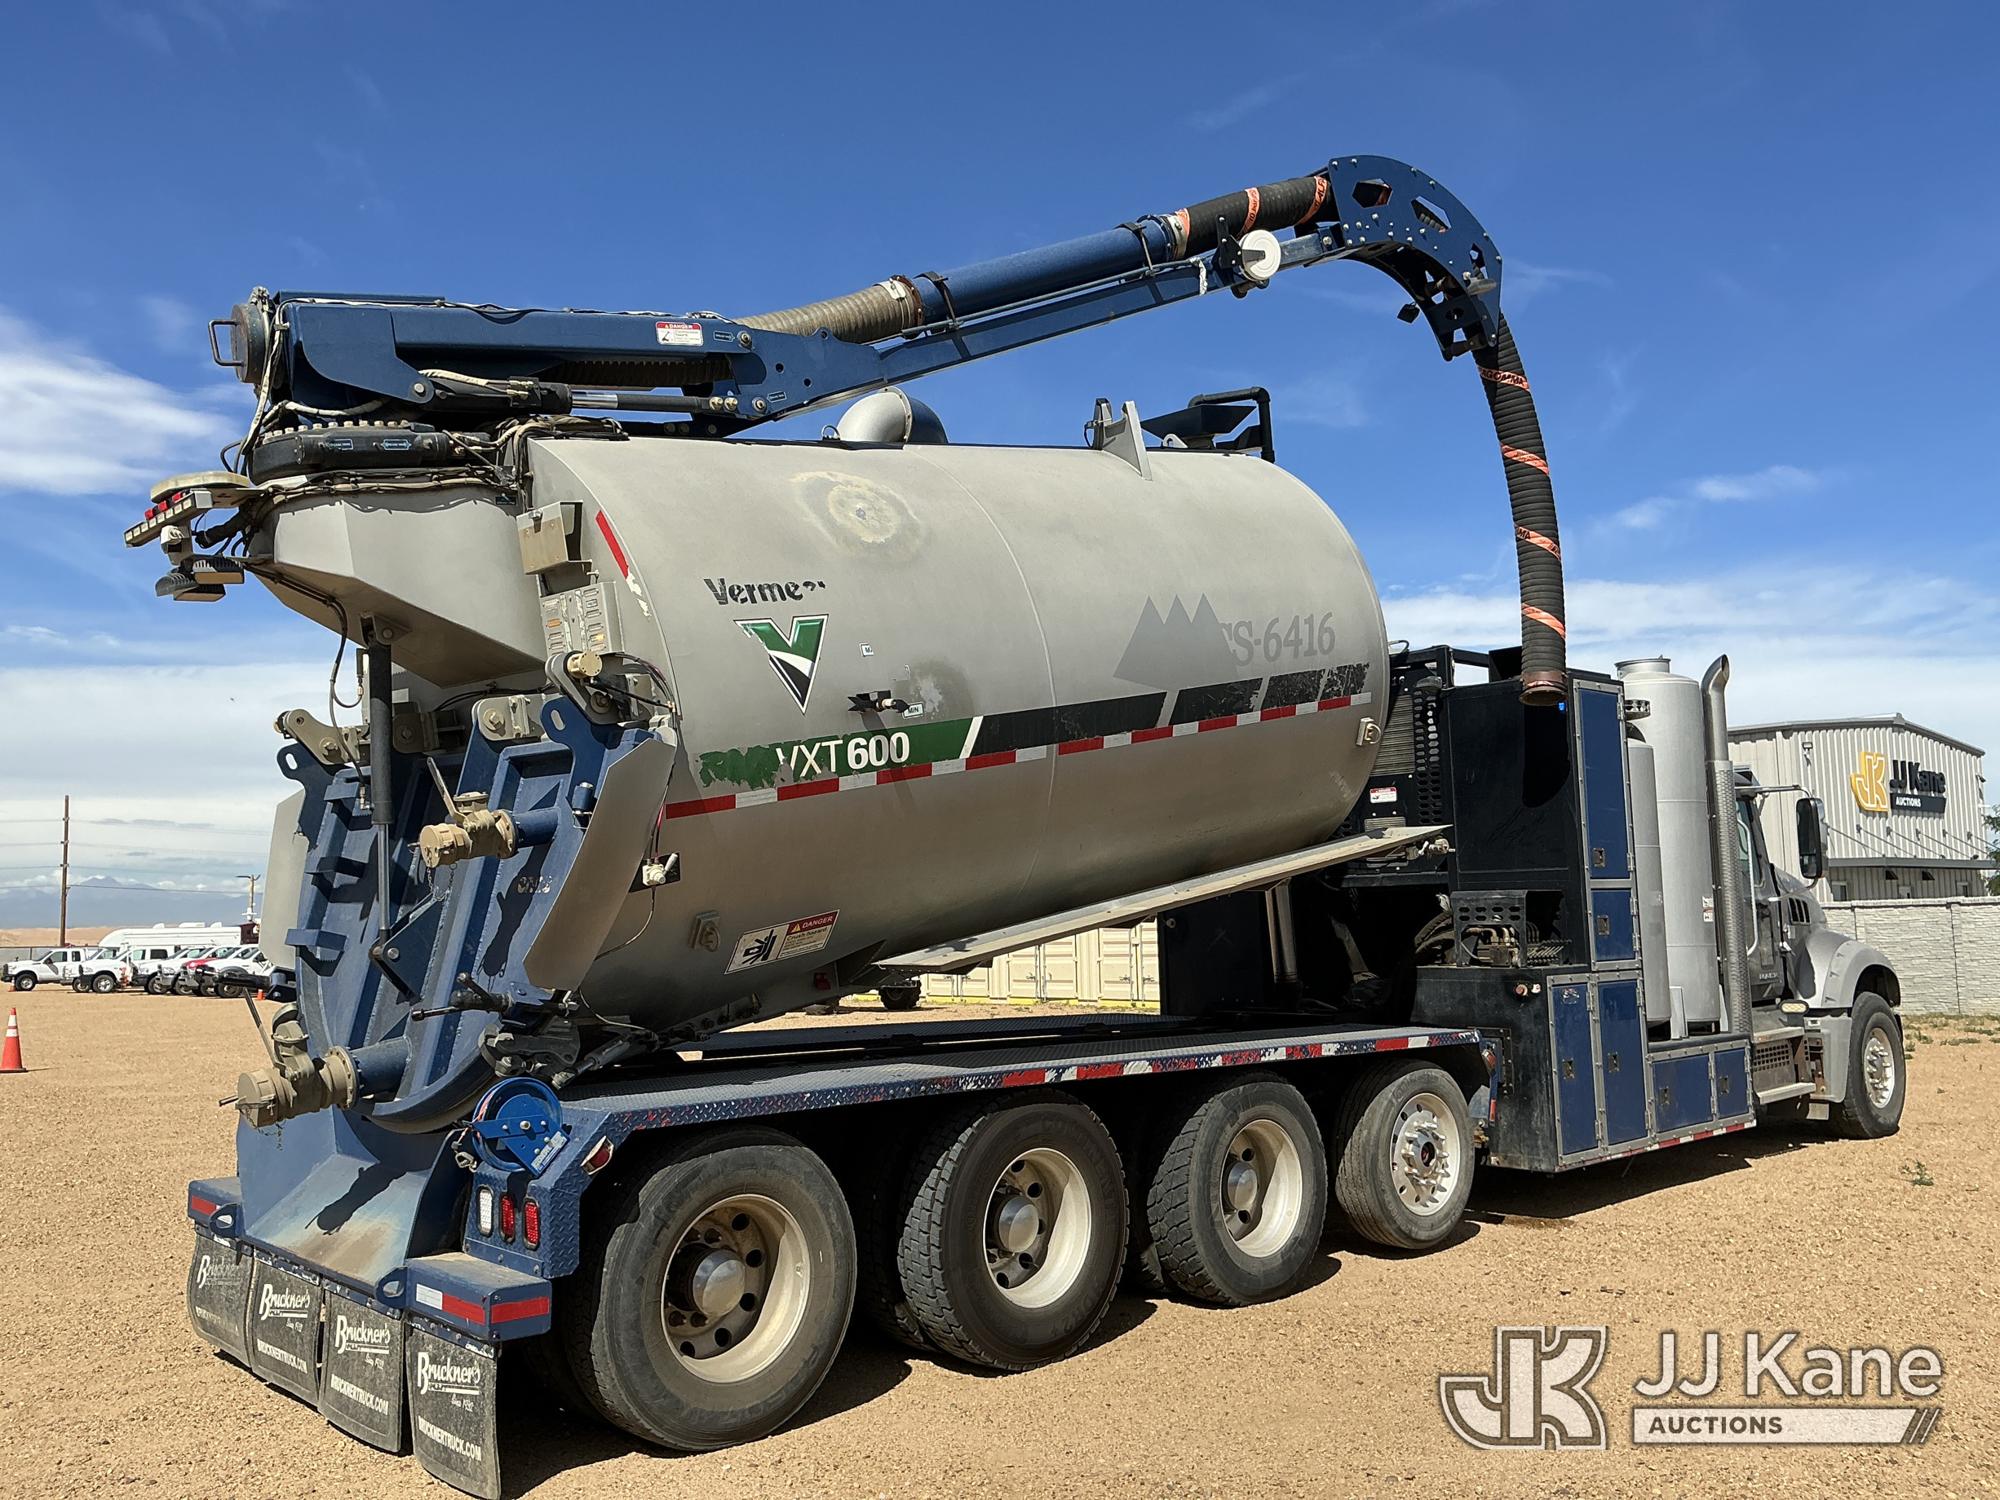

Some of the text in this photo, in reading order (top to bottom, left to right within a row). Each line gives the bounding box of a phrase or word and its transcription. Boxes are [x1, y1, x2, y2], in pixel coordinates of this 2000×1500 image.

[1908, 761, 1946, 794] Kane
[1895, 796, 1922, 807] AUCTIONS
[802, 916, 834, 929] DANGER
[335, 1315, 391, 1354] Bruckner's
[417, 1351, 481, 1395] Bruckner's
